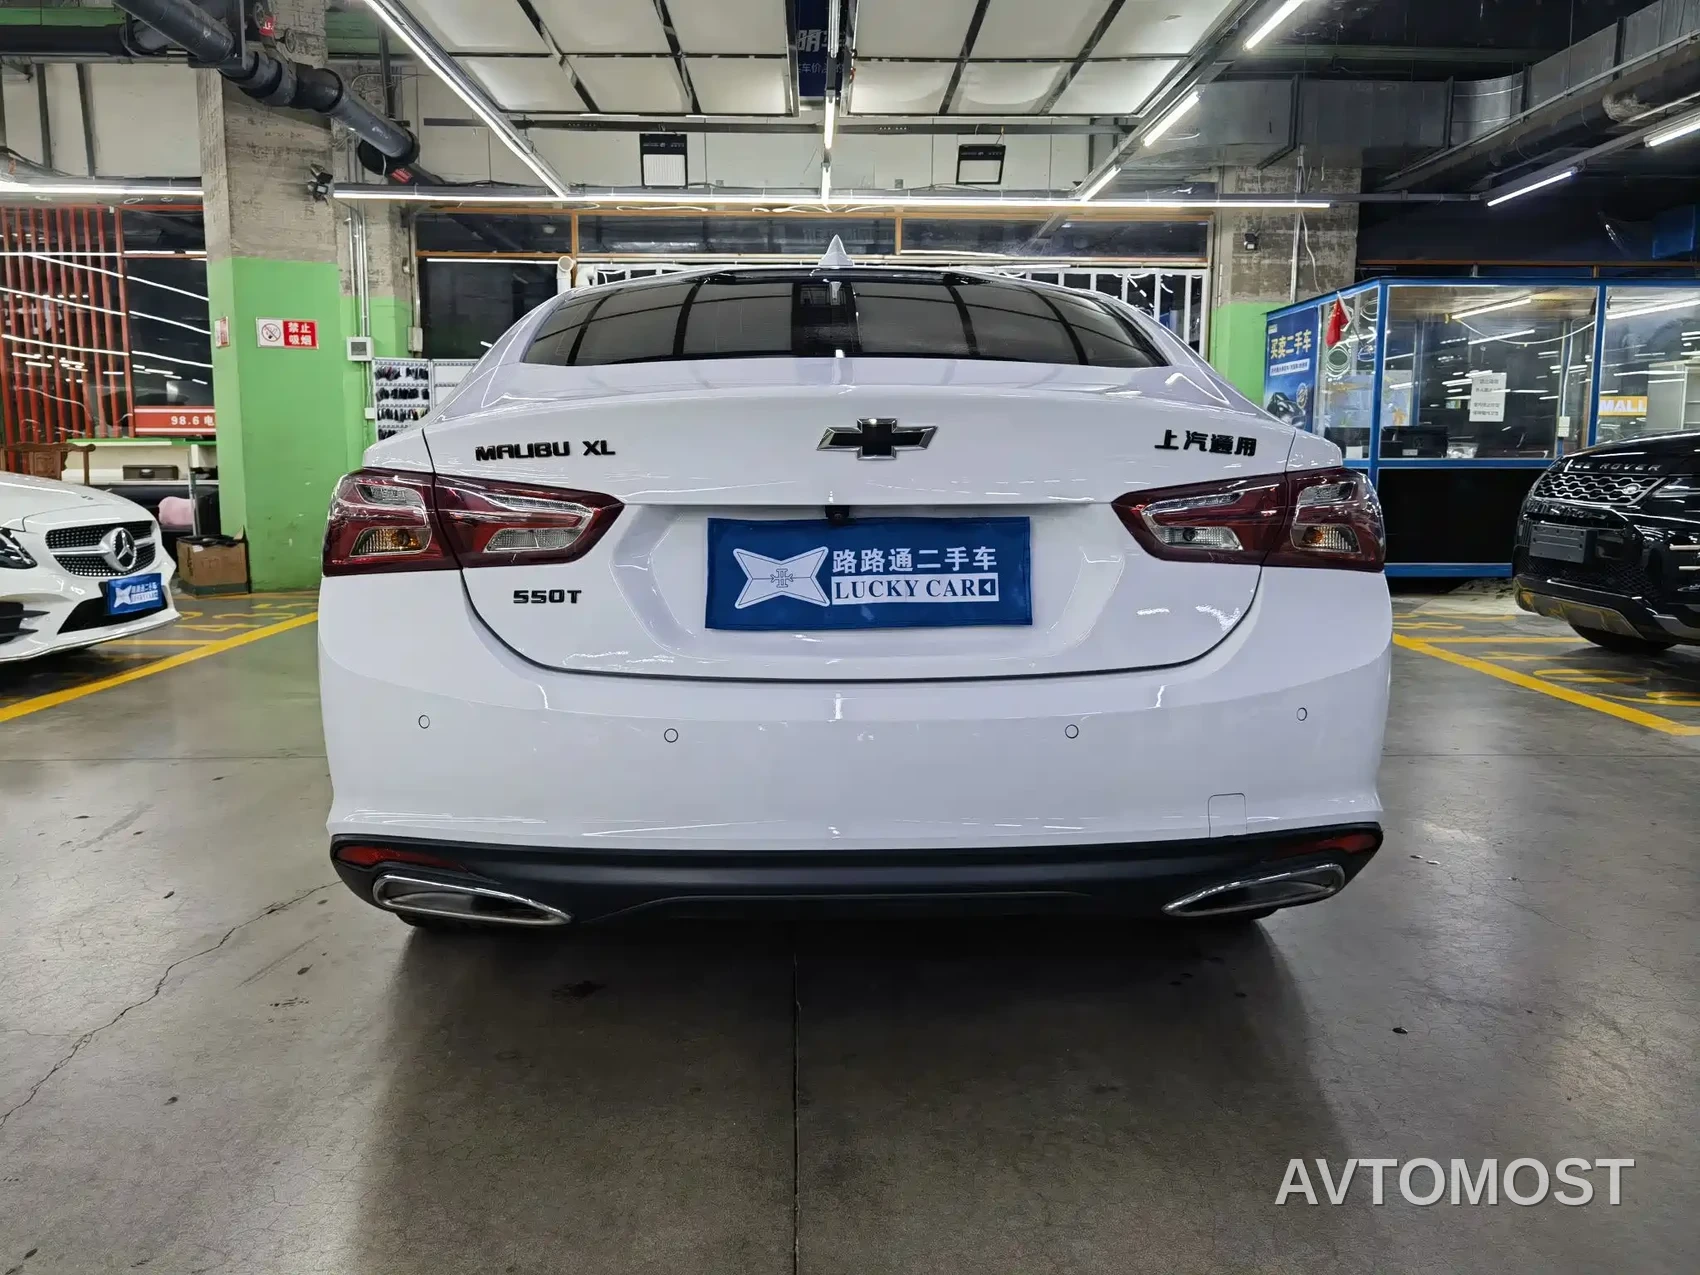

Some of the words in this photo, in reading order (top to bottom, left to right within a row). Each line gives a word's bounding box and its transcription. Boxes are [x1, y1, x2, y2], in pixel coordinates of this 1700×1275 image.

[288, 322, 311, 333] 禁止
[288, 334, 312, 346] 吸烟
[171, 416, 199, 425] 98.6
[475, 441, 570, 461] MALIBU
[582, 440, 616, 456] XL
[1154, 429, 1257, 457] 上汽通用
[832, 546, 997, 574] 路路通二手车
[513, 589, 582, 604] 550T
[835, 579, 919, 600] LUCKY
[926, 578, 977, 598] CAR
